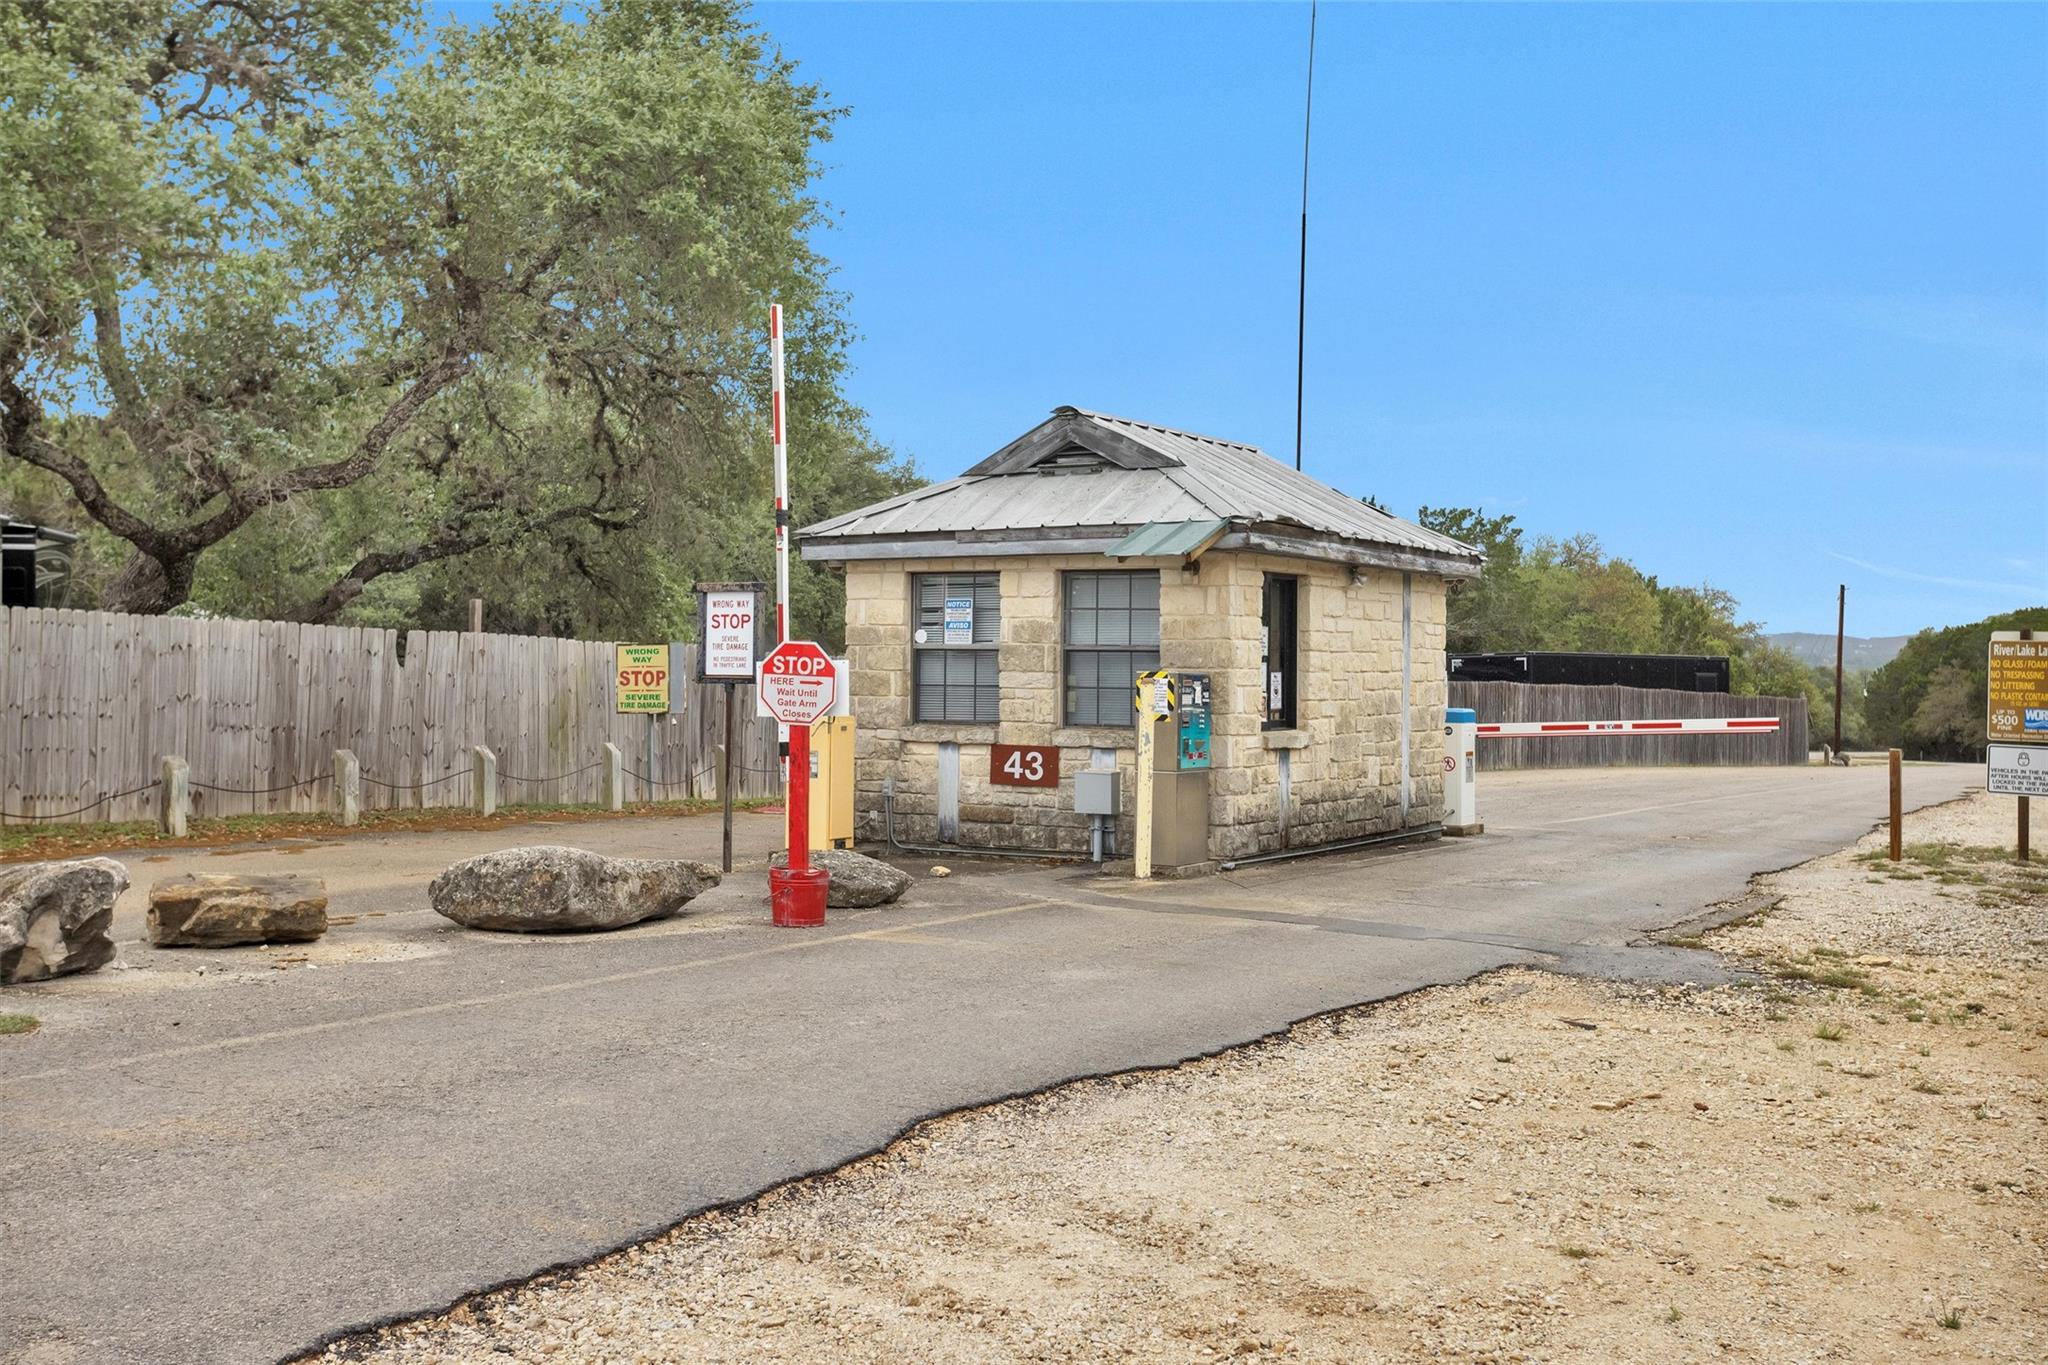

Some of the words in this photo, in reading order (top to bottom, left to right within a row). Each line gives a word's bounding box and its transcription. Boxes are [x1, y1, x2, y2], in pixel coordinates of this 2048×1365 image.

[712, 600, 734, 608] WRONG
[736, 600, 750, 608] WAY
[711, 613, 751, 629] STOP
[726, 643, 748, 651] DAMAGE
[2038, 645, 2048, 657] La
[772, 655, 826, 675] STOP
[1991, 659, 2001, 668] NO
[619, 670, 666, 687] STOP
[1990, 670, 2001, 679] NO
[2003, 671, 2045, 680] TRESPASSING
[770, 677, 795, 686] HERE
[1990, 681, 2001, 689] NO
[2002, 681, 2035, 690] LITTERING
[776, 688, 795, 696] Wait
[797, 689, 818, 697] Until
[1990, 691, 2000, 700] NO
[2001, 692, 2024, 701] PLASTIC
[777, 698, 797, 707] Gate
[799, 700, 817, 708] Arm
[782, 709, 812, 718] Closes
[1991, 714, 2018, 726] $500
[1003, 750, 1044, 781] 43
